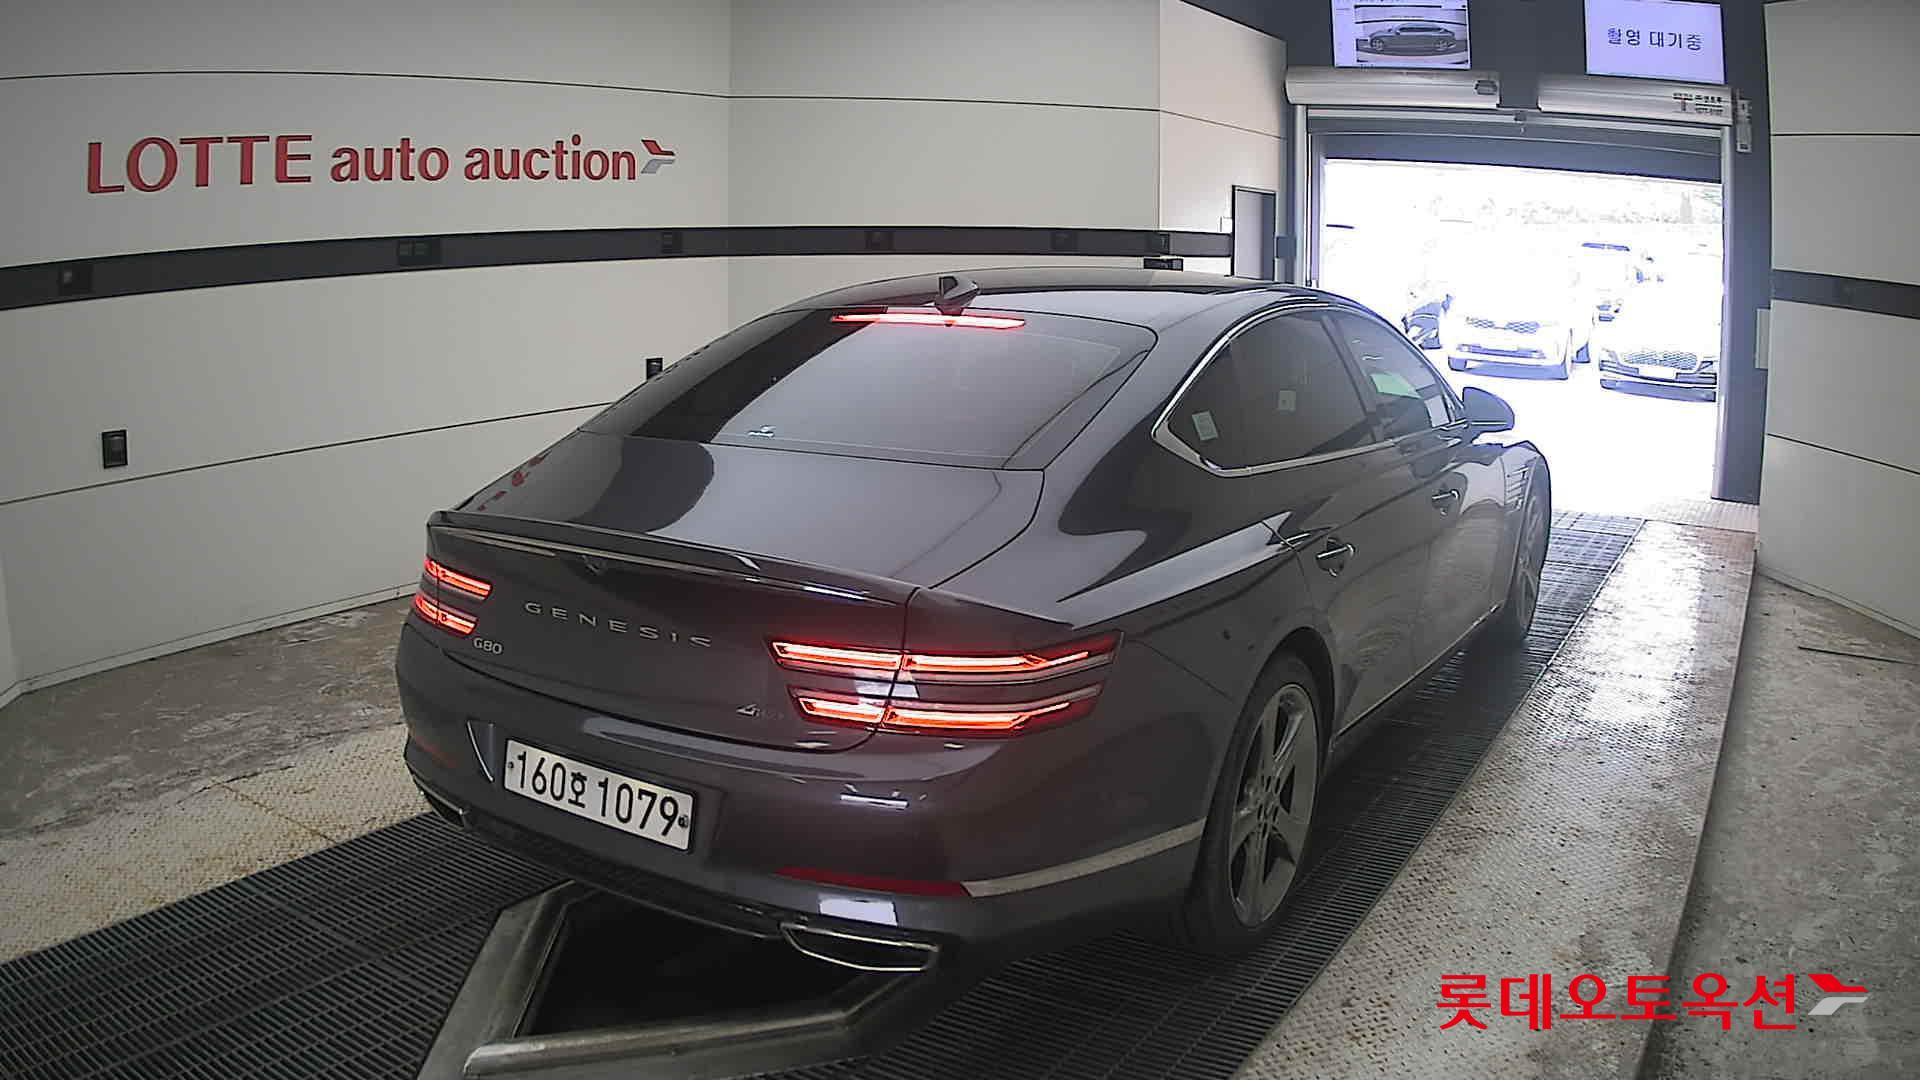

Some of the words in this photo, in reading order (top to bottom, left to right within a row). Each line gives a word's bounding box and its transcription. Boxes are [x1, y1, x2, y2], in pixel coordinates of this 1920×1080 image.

[1649, 31, 1702, 51] 대기중
[87, 135, 313, 194] LOTTE
[330, 138, 450, 183] auto
[463, 135, 638, 182] auction
[524, 602, 712, 648] GENESIS
[473, 637, 503, 655] G80
